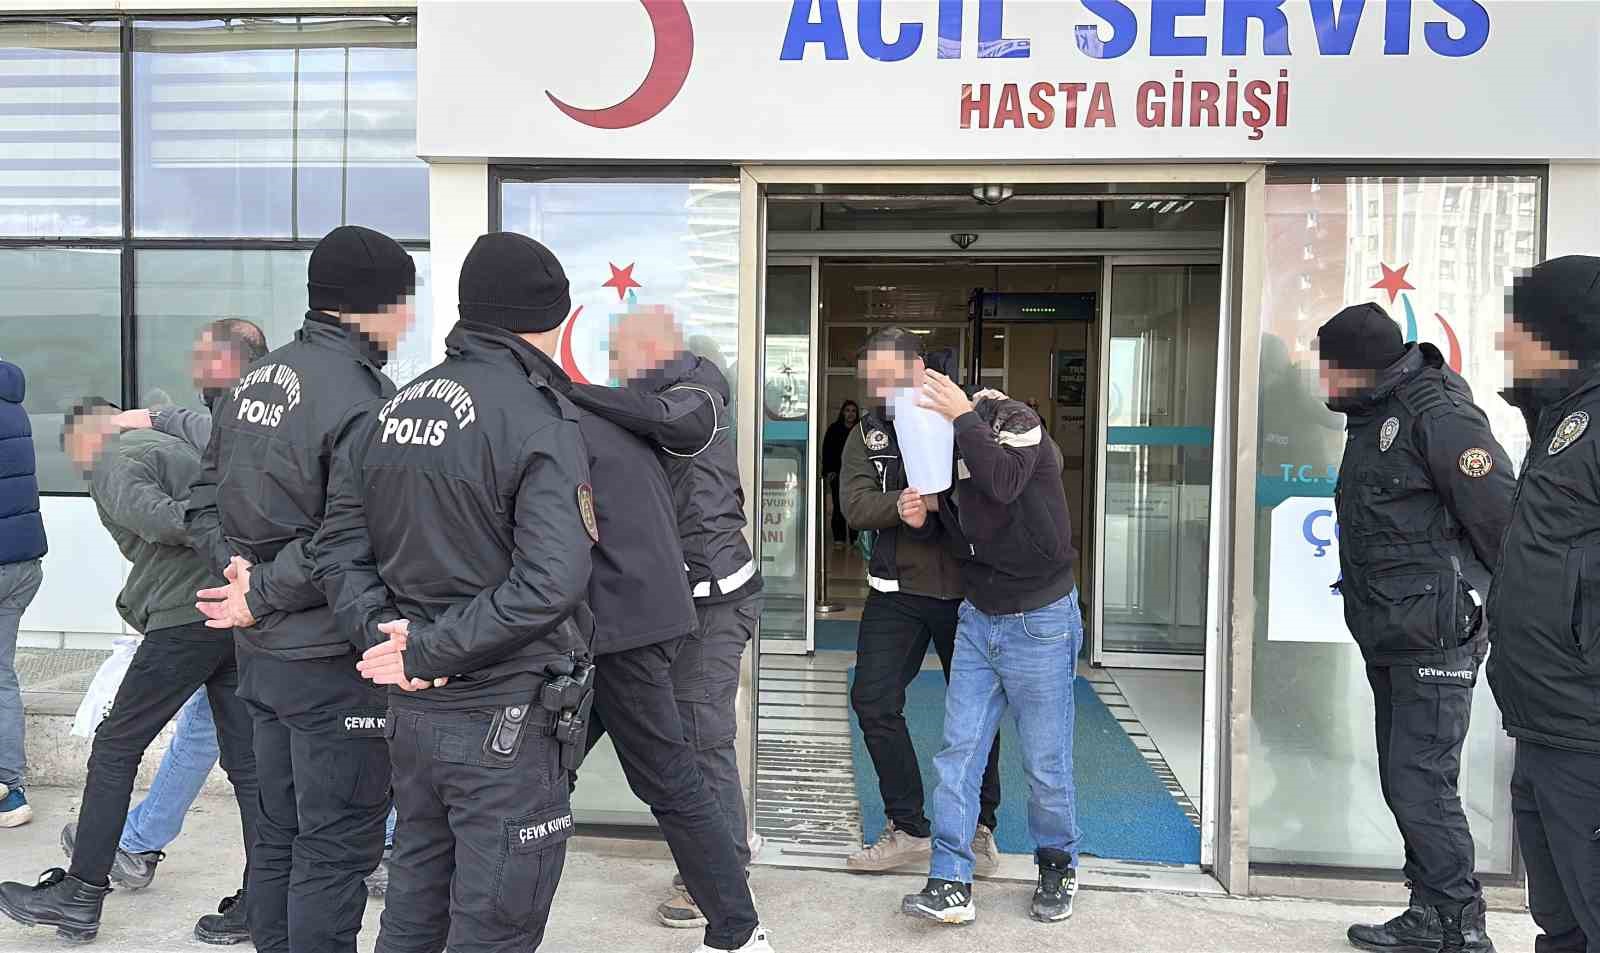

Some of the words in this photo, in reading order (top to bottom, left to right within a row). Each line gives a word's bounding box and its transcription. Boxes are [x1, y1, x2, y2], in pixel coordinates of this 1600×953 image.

[960, 82, 1117, 129] HASTA
[1136, 70, 1289, 141] GİRİŞİ
[1280, 463, 1319, 483] T.C.
